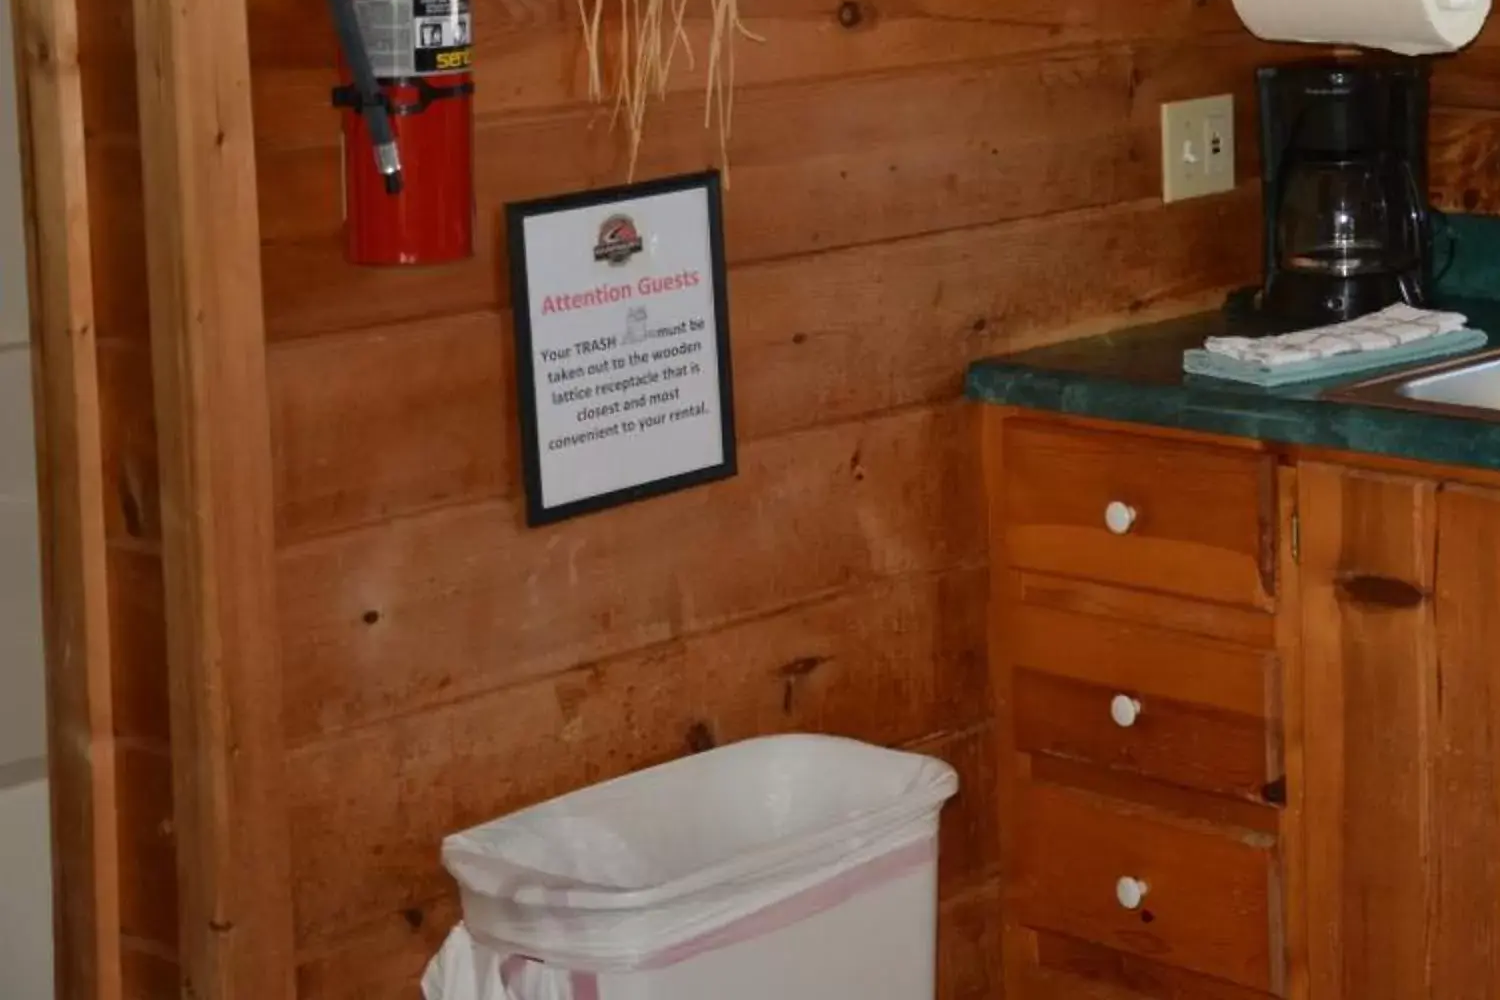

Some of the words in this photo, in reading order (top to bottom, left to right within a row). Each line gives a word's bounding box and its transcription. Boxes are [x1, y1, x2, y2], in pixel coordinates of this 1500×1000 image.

[541, 284, 631, 316] Attention
[638, 270, 700, 295] Guests
[541, 348, 571, 362] Your
[574, 337, 617, 356] TRASH
[548, 368, 584, 383] taken
[587, 360, 609, 375] out
[612, 358, 625, 370] to
[628, 351, 648, 367] the
[651, 341, 702, 361] wooden
[551, 387, 592, 405] lattice
[595, 371, 658, 394] receptacle
[662, 365, 687, 380] that
[690, 362, 700, 376] is
[576, 402, 619, 422] closest
[623, 395, 646, 411] and
[649, 388, 679, 405] most
[548, 424, 619, 450] convenient
[621, 421, 635, 433] to
[638, 414, 666, 432] your
